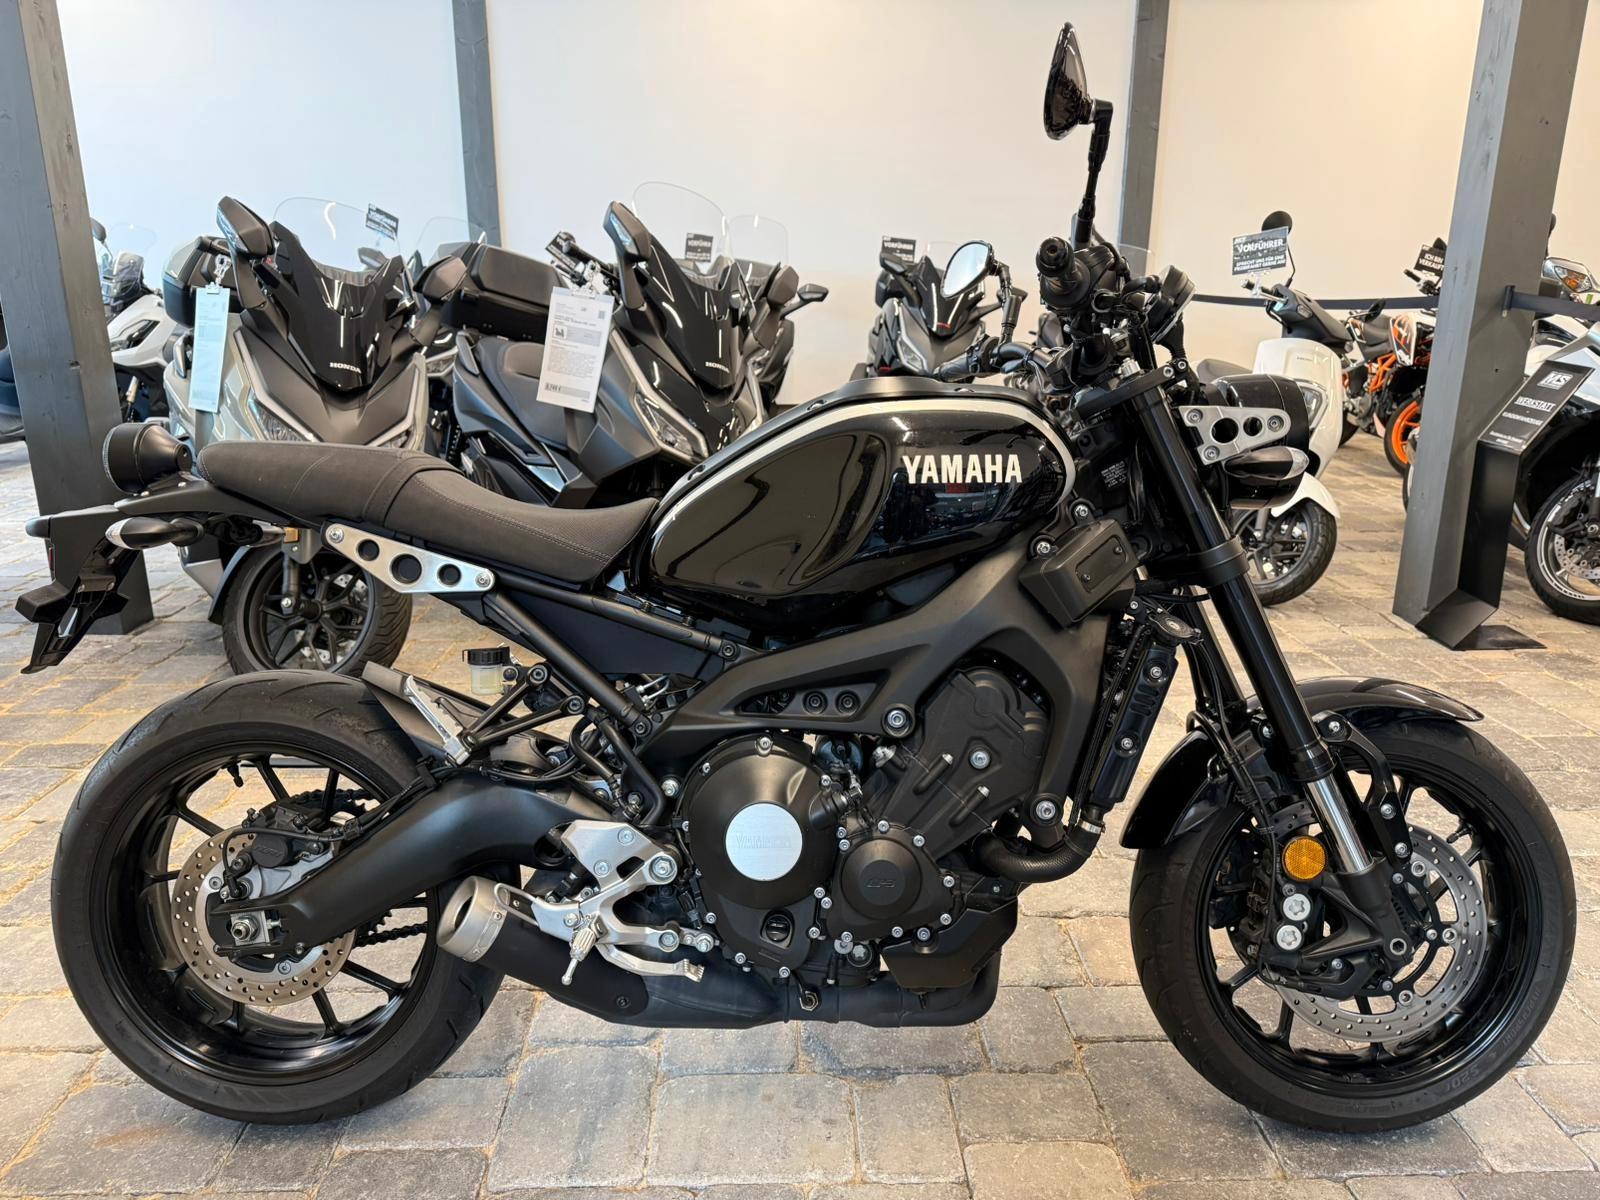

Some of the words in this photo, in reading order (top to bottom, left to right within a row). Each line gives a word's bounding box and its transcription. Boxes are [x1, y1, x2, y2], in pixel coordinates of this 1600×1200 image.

[329, 361, 362, 374] HONDA
[705, 361, 730, 374] HONDA
[1514, 396, 1557, 412] WERKSTATT
[902, 453, 1022, 484] YAMAHA
